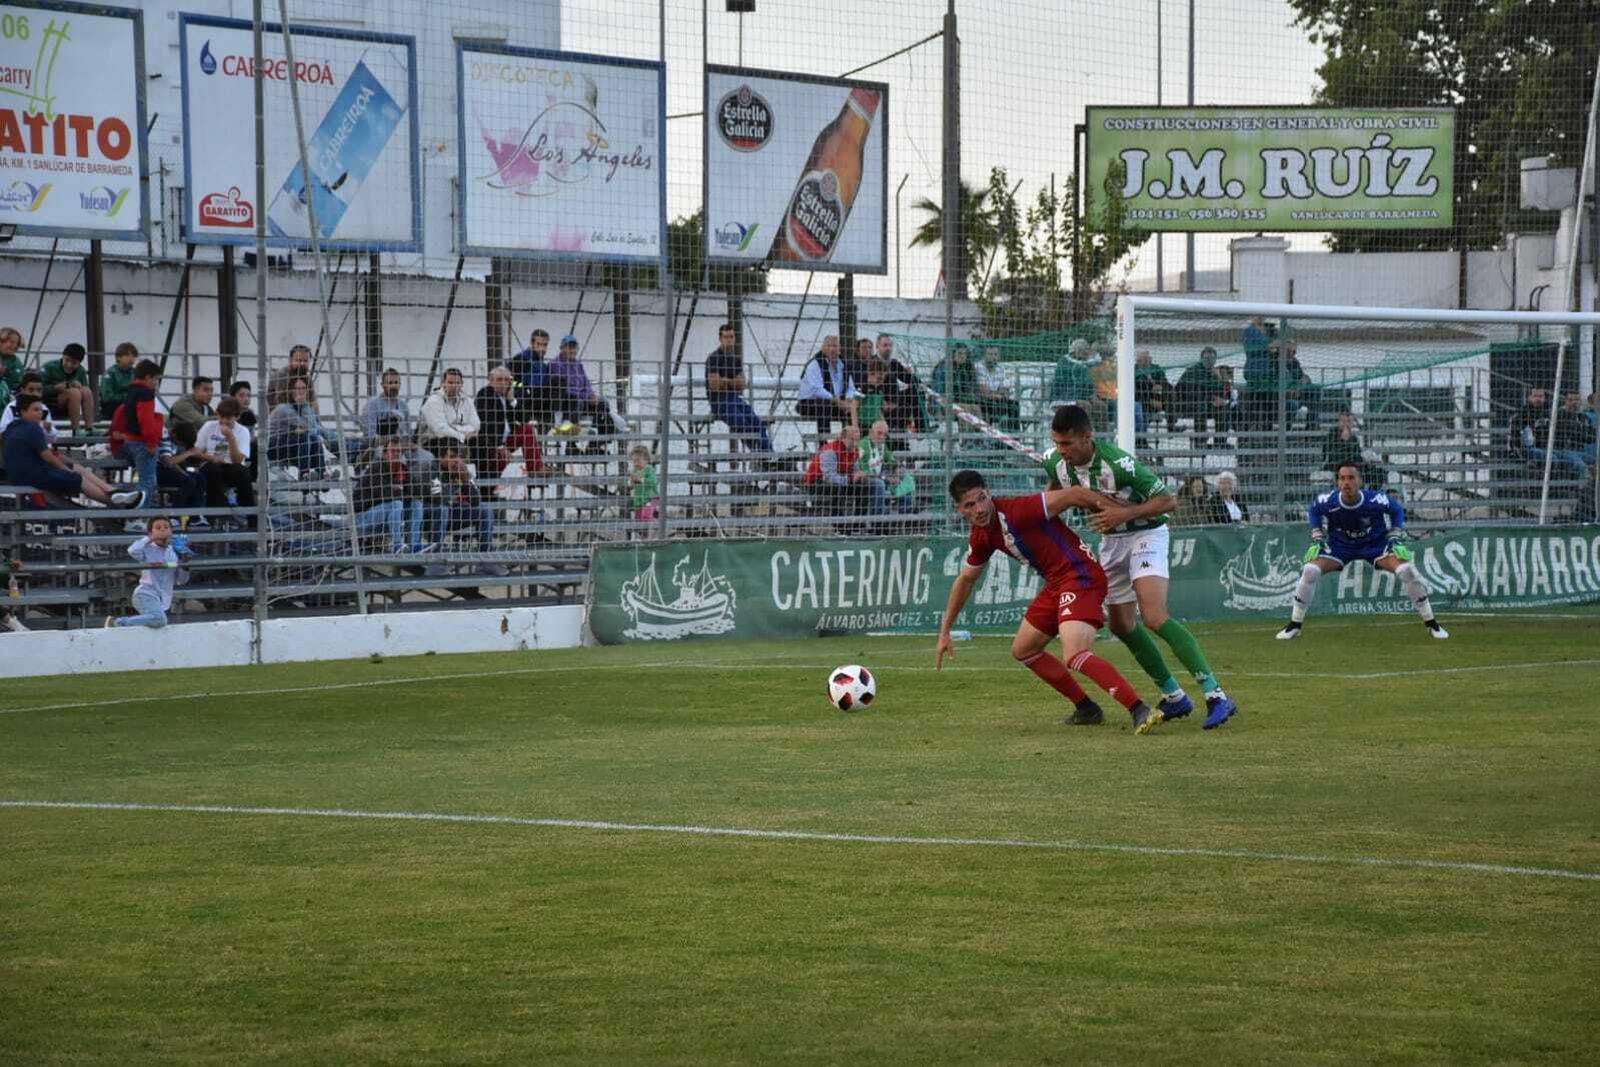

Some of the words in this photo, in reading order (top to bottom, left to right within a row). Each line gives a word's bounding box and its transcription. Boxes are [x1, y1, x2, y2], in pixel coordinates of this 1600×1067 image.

[222, 55, 334, 85] CAREROÁ
[724, 102, 767, 122] Estrella
[725, 119, 765, 138] Galicia
[1104, 117, 1240, 130] CONSTRUCCIONES
[1243, 118, 1263, 130] EN
[1266, 118, 1338, 129] GENERAL
[1339, 118, 1350, 129] Y
[1353, 118, 1396, 129] OBRA
[1399, 117, 1439, 129] CIVIL
[529, 133, 564, 164] Los
[571, 145, 652, 183] Angeles
[1120, 148, 1245, 199] J.M.
[1260, 133, 1440, 199] RUÍZ
[75, 162, 87, 173] DE
[87, 163, 133, 176] BARRAMEDA
[205, 206, 248, 217] BARATITO
[799, 185, 838, 232] Estrella
[1351, 210, 1365, 219] DE
[1369, 210, 1439, 219] BARRAMEDA
[771, 547, 933, 611] CATERING
[1338, 601, 1376, 614] ARENA
[815, 612, 866, 630] ÁLVARO
[867, 609, 922, 629] SÁNCHEZ
